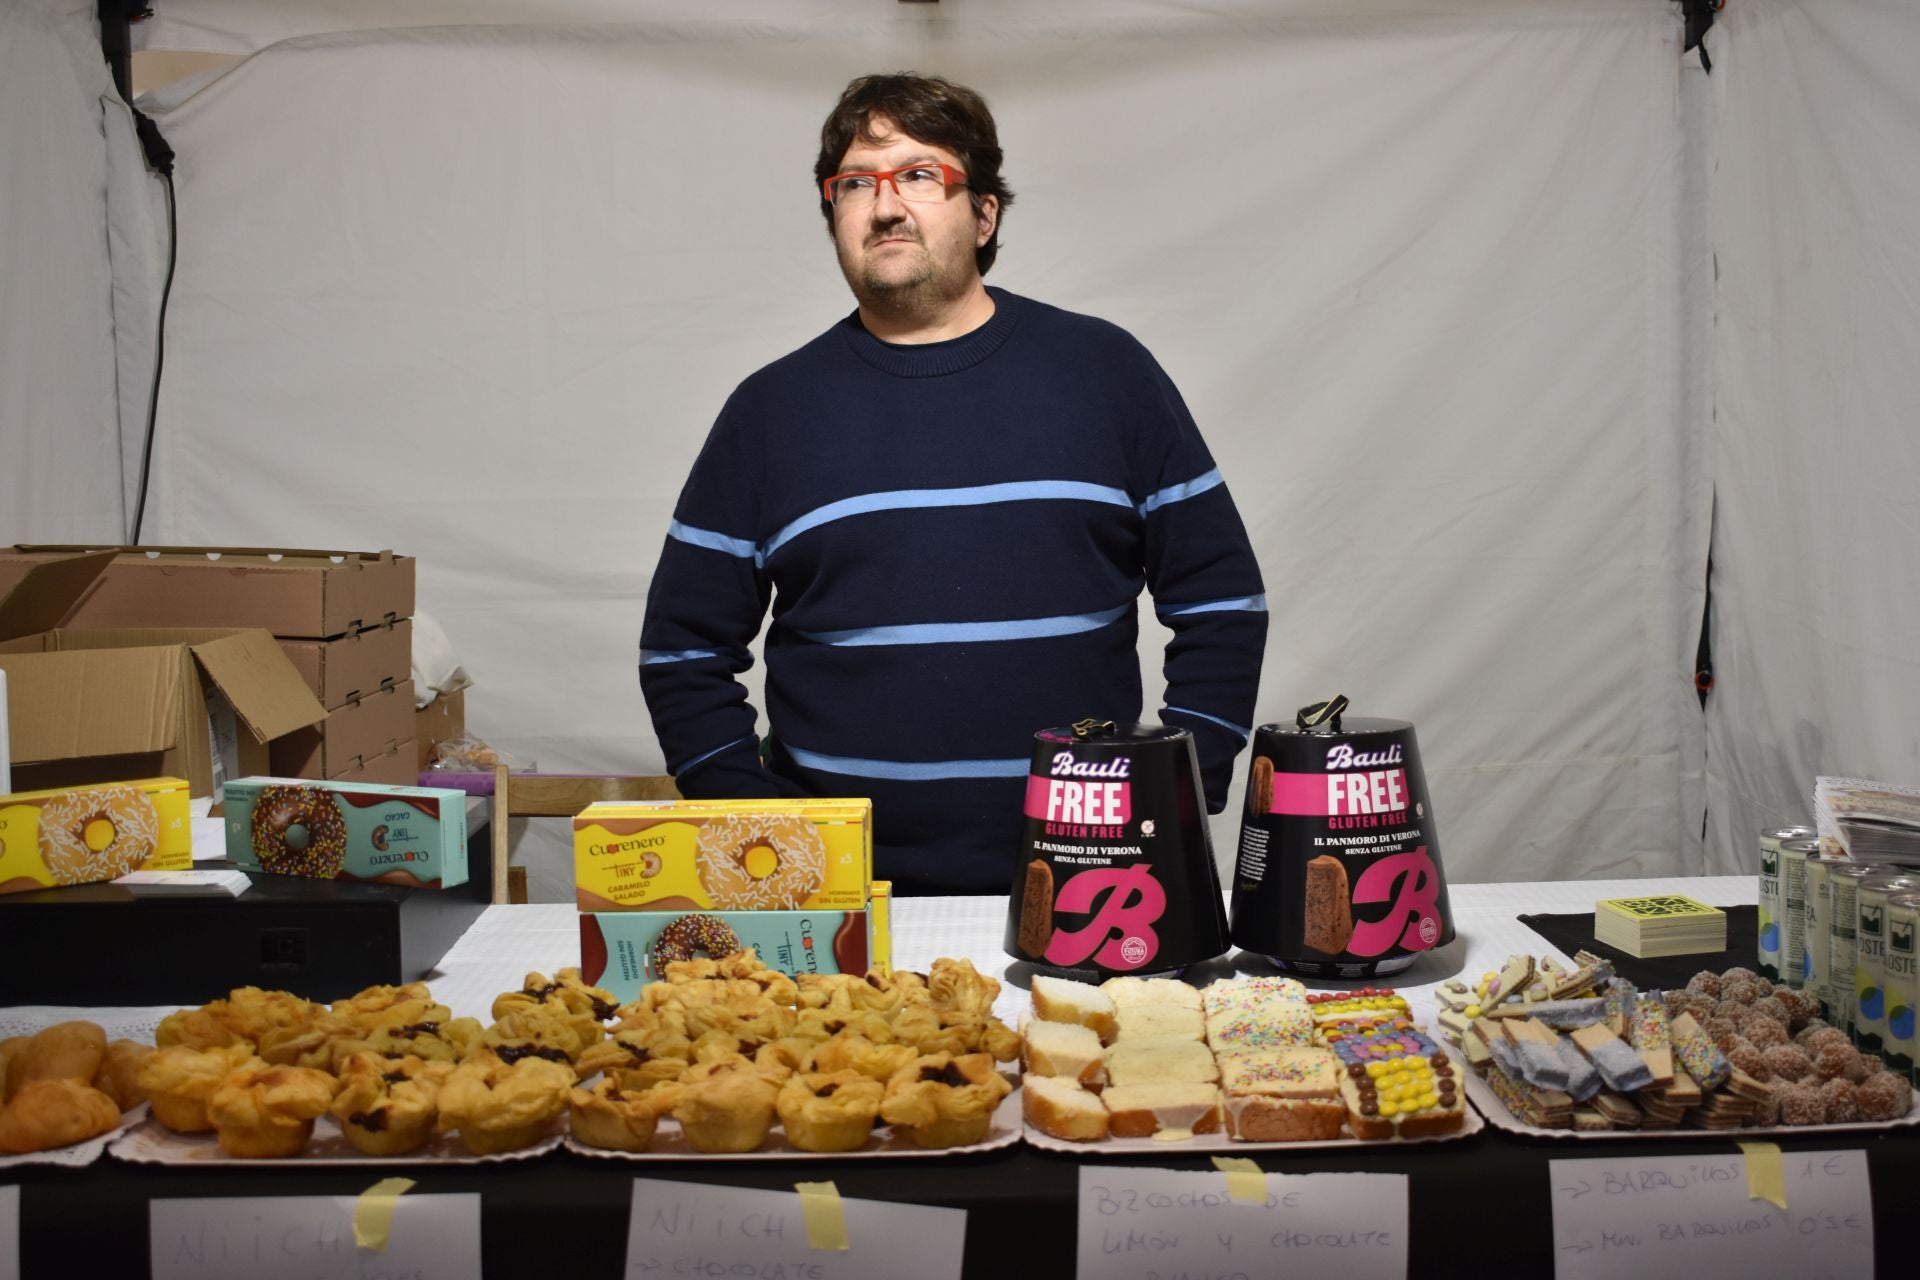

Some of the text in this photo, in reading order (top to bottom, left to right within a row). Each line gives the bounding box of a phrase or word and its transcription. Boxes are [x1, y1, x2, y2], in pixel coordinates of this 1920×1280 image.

[1050, 751, 1131, 777] Bauli
[1326, 743, 1402, 770] Bauli
[1327, 769, 1405, 816] FREE
[1046, 779, 1124, 825] FREE
[385, 812, 410, 822] CACAO
[1328, 812, 1408, 829] GLUTEN FREE
[1045, 823, 1124, 839] GLUTEN FREE
[1314, 829, 1421, 846] IL PANMORO DI VERONA
[1033, 841, 1142, 855] IL PANMORO DI VERONA
[1345, 844, 1402, 855] SENZA GLUTINE
[1054, 855, 1112, 865] SENZA GLUTINE
[608, 880, 650, 893] CARAMELO
[613, 890, 645, 901] SALADO
[800, 919, 818, 974] Cuoren
[617, 940, 631, 981] SIN GLUTEN
[626, 940, 639, 979] HORNEADO
[1264, 1191, 1302, 1209] DE
[672, 1256, 825, 1280] CHOCOLATE
